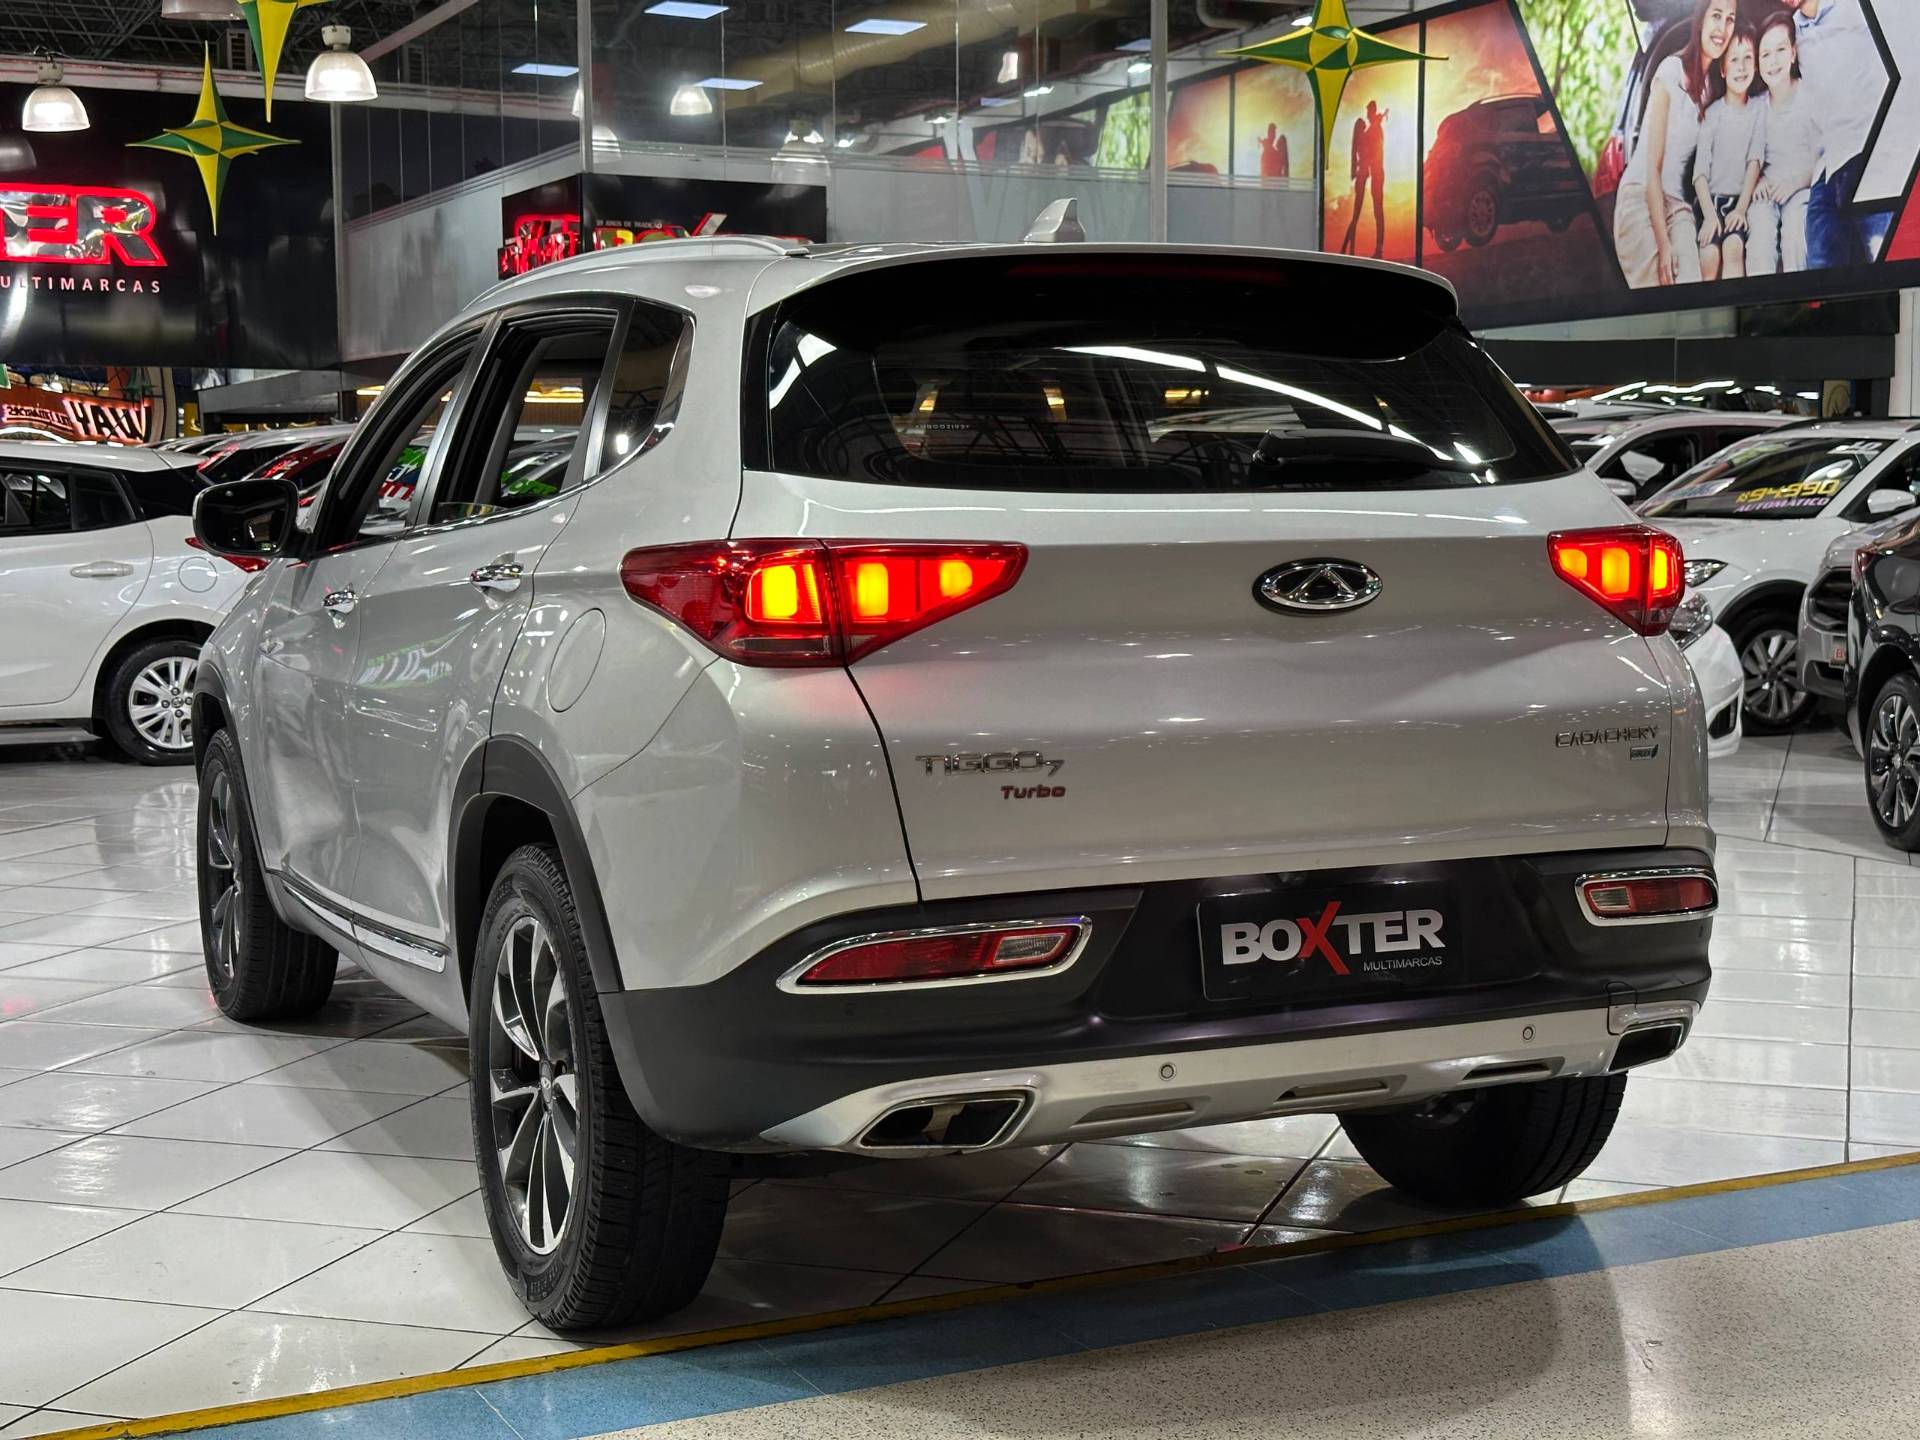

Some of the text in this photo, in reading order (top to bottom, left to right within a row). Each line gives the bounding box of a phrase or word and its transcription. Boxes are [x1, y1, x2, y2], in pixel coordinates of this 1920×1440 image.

[0, 275, 160, 293] ULTIMARCAS
[1001, 784, 1066, 799] Turbo
[1220, 901, 1446, 975] BOXTER
[1363, 956, 1442, 971] MULTIMARCAS
